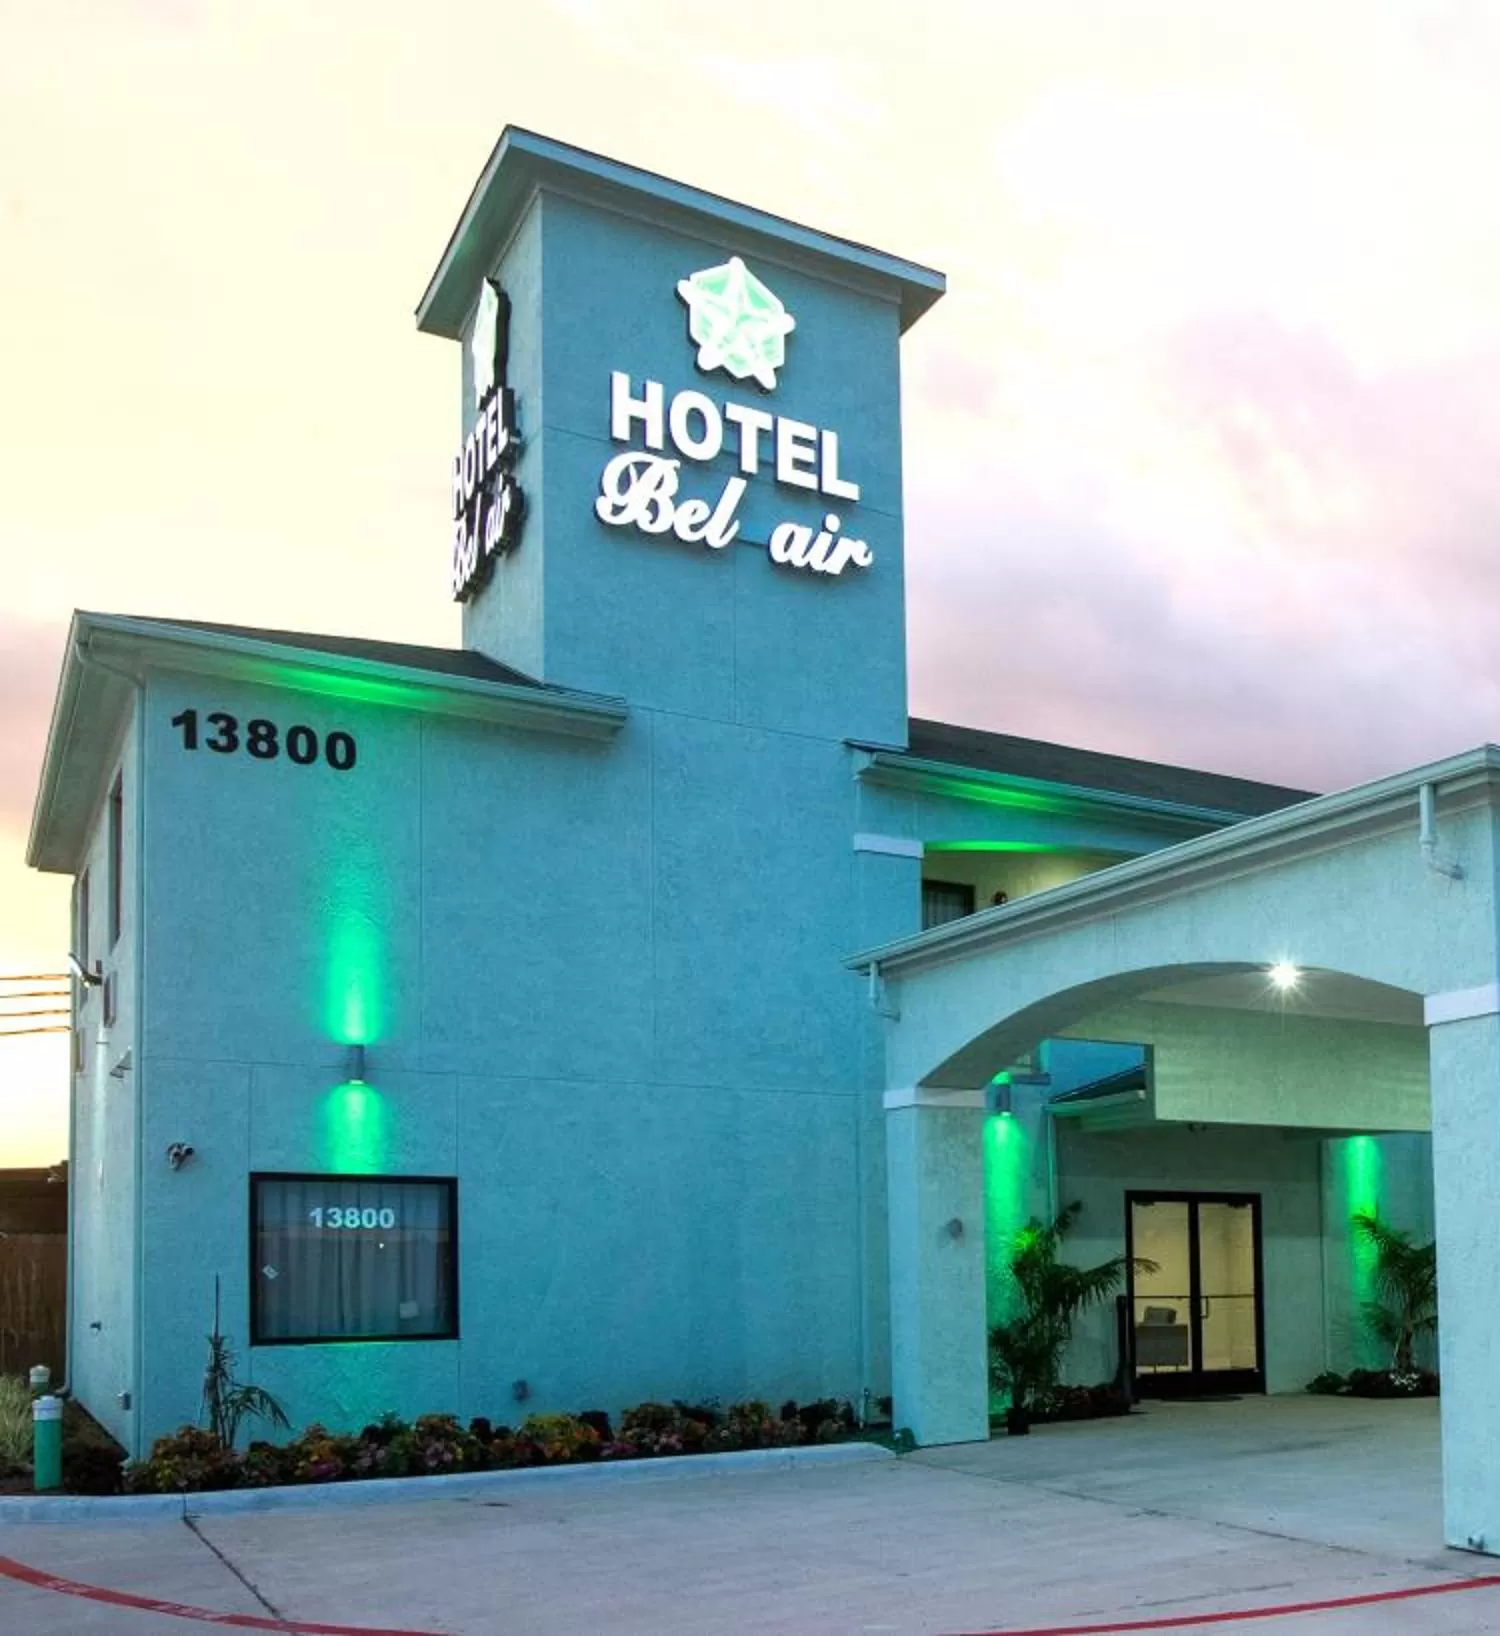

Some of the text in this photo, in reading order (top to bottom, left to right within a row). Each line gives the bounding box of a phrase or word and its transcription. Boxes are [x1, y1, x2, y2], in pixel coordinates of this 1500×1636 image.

[452, 386, 509, 521] HOTEL
[609, 370, 860, 502] HOTEL
[594, 450, 873, 576] Bel air
[171, 708, 357, 771] 13800
[308, 1206, 396, 1230] 13800
